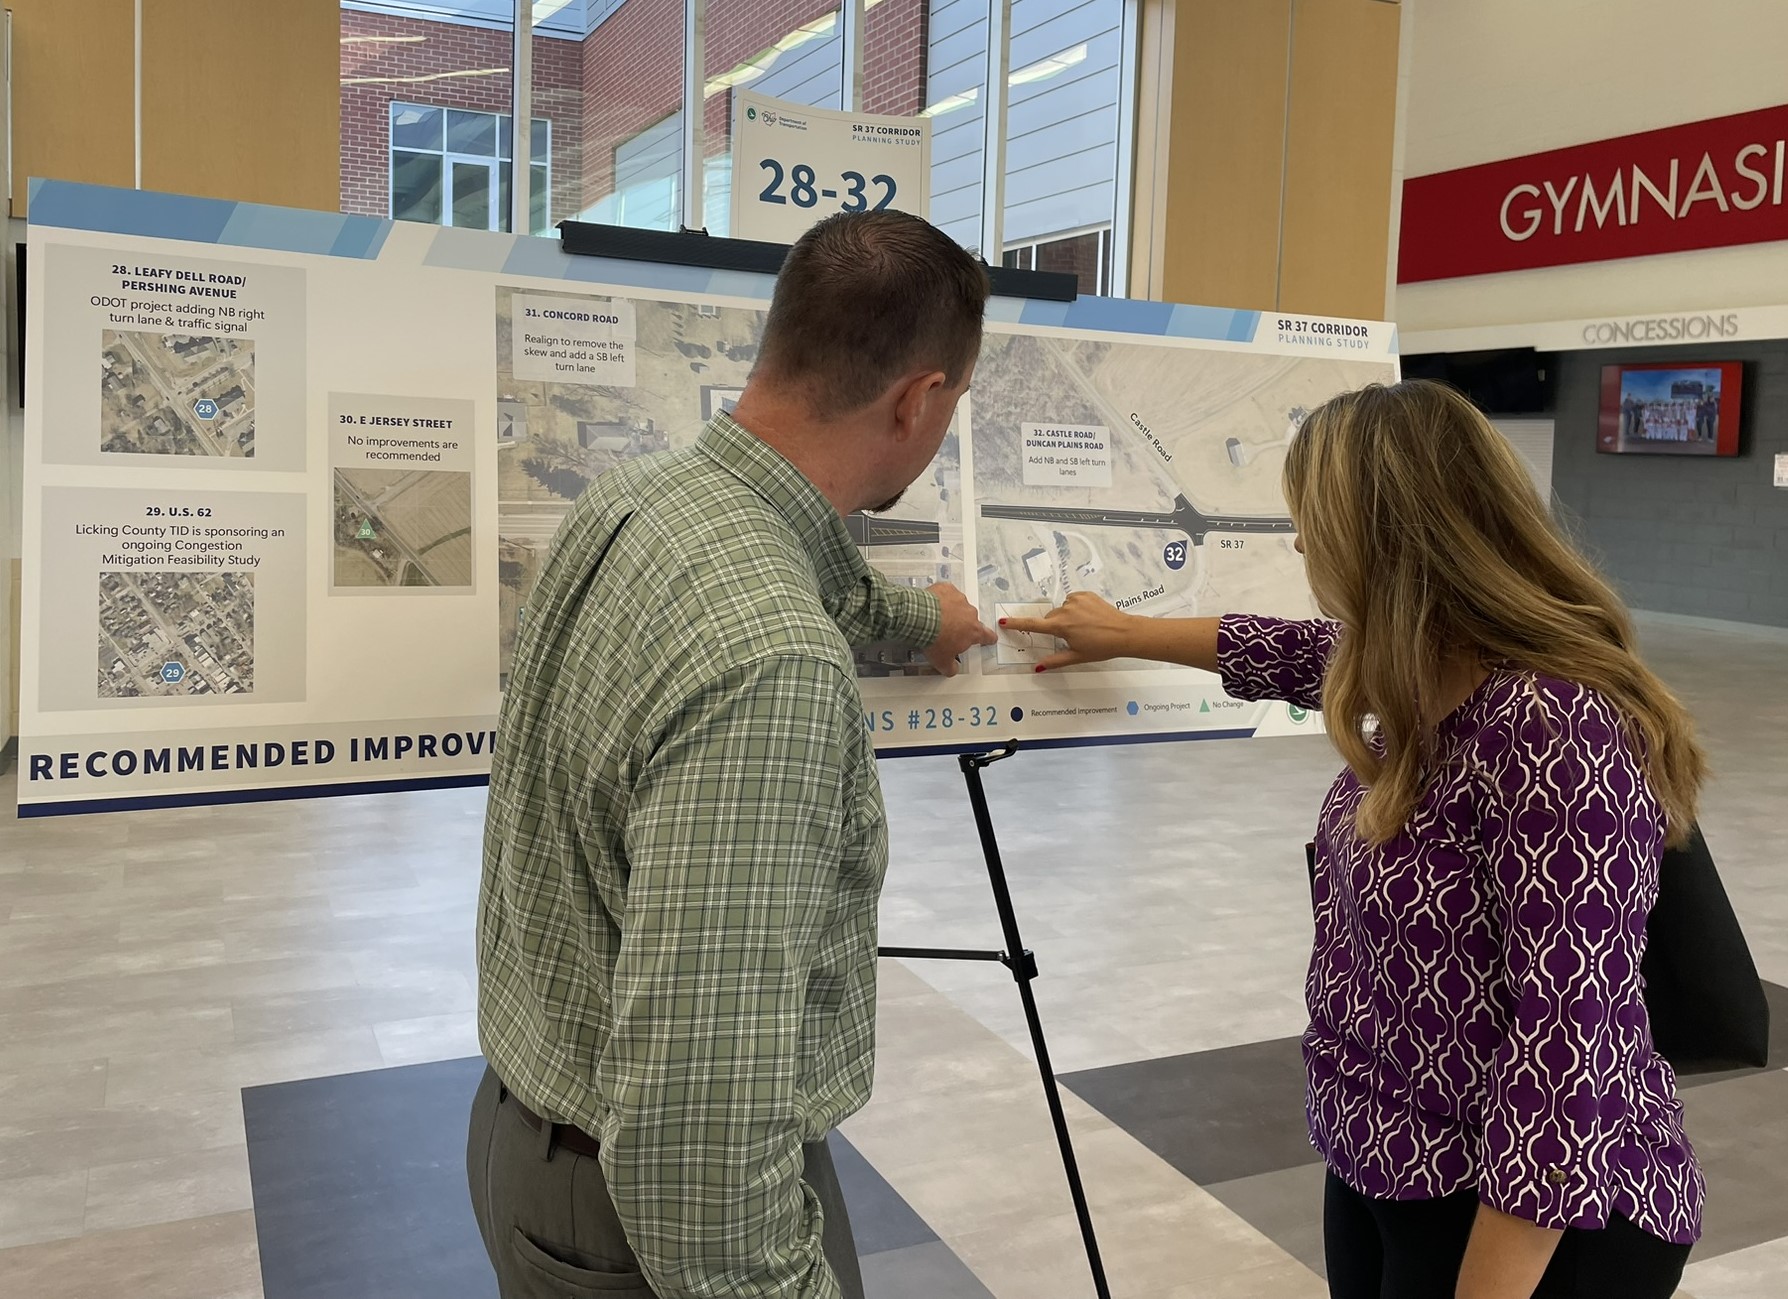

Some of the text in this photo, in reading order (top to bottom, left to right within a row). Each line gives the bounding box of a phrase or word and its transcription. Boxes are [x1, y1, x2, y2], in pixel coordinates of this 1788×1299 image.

[877, 127, 920, 136] CORRIDOR
[852, 135, 892, 144] PLANNING
[759, 158, 897, 212] 28-32
[1500, 140, 1785, 241] GYMNASI
[112, 265, 246, 287] 28. LEAFY DELL ROAD/
[122, 280, 237, 299] PERSHING AVENUE
[90, 296, 265, 321] ODOT project adding NB right
[526, 308, 618, 324] 31. CONCORD ROAD
[110, 313, 248, 333] turn lane & traffic signal
[1278, 320, 1368, 337] SR 37 CORRIDOR
[1583, 314, 1738, 344] CONCESSIONS
[525, 334, 558, 346] Realign
[573, 340, 606, 348] remove
[610, 341, 624, 350] the
[1279, 334, 1369, 349] PLANNING STUDY
[524, 348, 548, 356] skew
[550, 350, 566, 358] and
[569, 352, 586, 360] add
[596, 352, 607, 361] SB
[610, 354, 624, 362] left
[556, 363, 596, 372] turn lane
[199, 404, 212, 413] 28
[340, 415, 452, 428] 30. E JERSEY STREET
[1046, 430, 1072, 438] CASTLE
[1074, 432, 1096, 440] ROAD/
[1130, 412, 1172, 462] Castle Road
[348, 436, 458, 449] No improvements are
[1026, 440, 1056, 448] DUNCAN
[1058, 441, 1083, 449] PLAINS
[366, 452, 441, 462] recommended
[1056, 457, 1068, 465] and
[146, 507, 212, 517] 29. U.S. 62
[76, 524, 285, 539] Licking County TID is sponsoring an
[122, 540, 242, 552] ongoing Congestion
[1221, 540, 1244, 548] SR 37
[102, 554, 261, 567] Mitigation Feasibility Study
[1166, 547, 1184, 561] 32
[1116, 584, 1165, 610] Plains Road
[166, 669, 180, 678] 29
[1031, 706, 1118, 716] Recommended Improvement
[1144, 702, 1190, 712] Ongoing Project
[1221, 701, 1244, 709] Change
[30, 740, 335, 780] RECOMMENDED
[908, 706, 998, 730] #28-32
